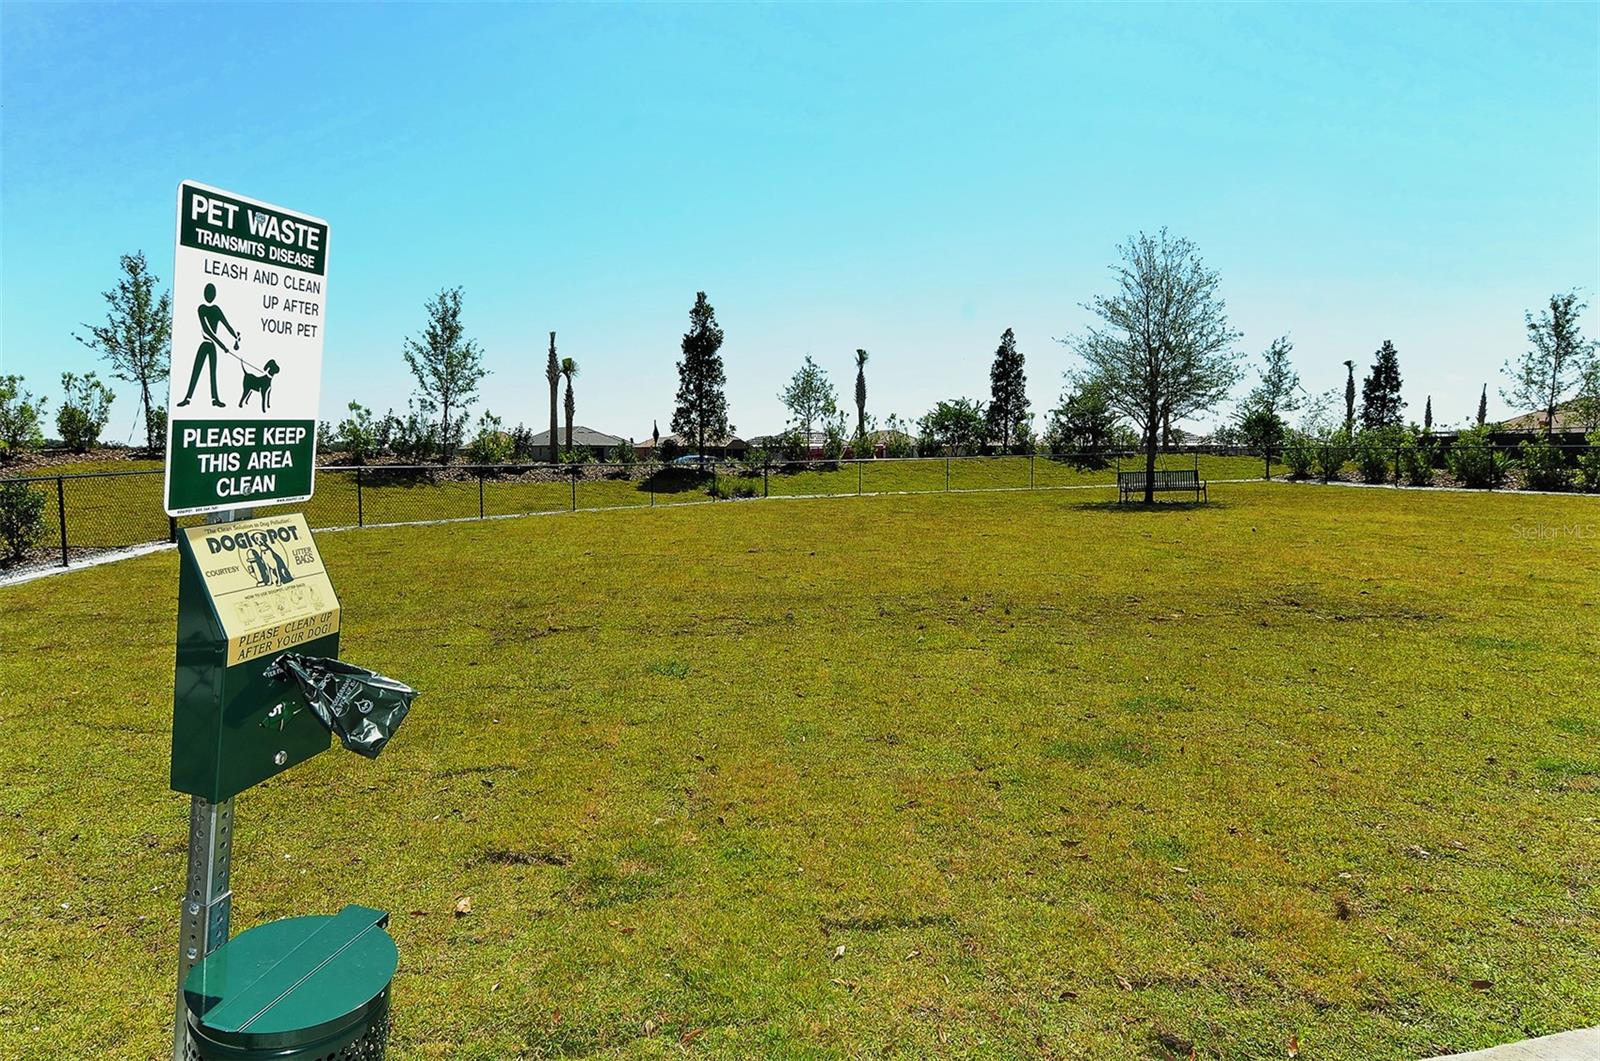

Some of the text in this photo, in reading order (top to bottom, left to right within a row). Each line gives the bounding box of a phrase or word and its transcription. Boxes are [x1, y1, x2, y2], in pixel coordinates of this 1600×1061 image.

[191, 193, 320, 251] PET WASTE
[195, 228, 315, 269] TRANSMITS DISEASE
[204, 258, 321, 295] LEASH AND CLEAN
[263, 295, 319, 316] UP AFTER
[261, 318, 317, 338] YOUR PET
[183, 427, 306, 448] PLEASE KEEP
[197, 450, 293, 474] THIS AREA
[216, 474, 276, 497] CLEAN
[292, 546, 312, 556] LITTER
[295, 554, 315, 565] BAGS
[205, 566, 240, 578] COURTESY
[239, 611, 333, 648] PLEASE CLEAN UP
[237, 623, 332, 661] AFTER YOUR DOG!
